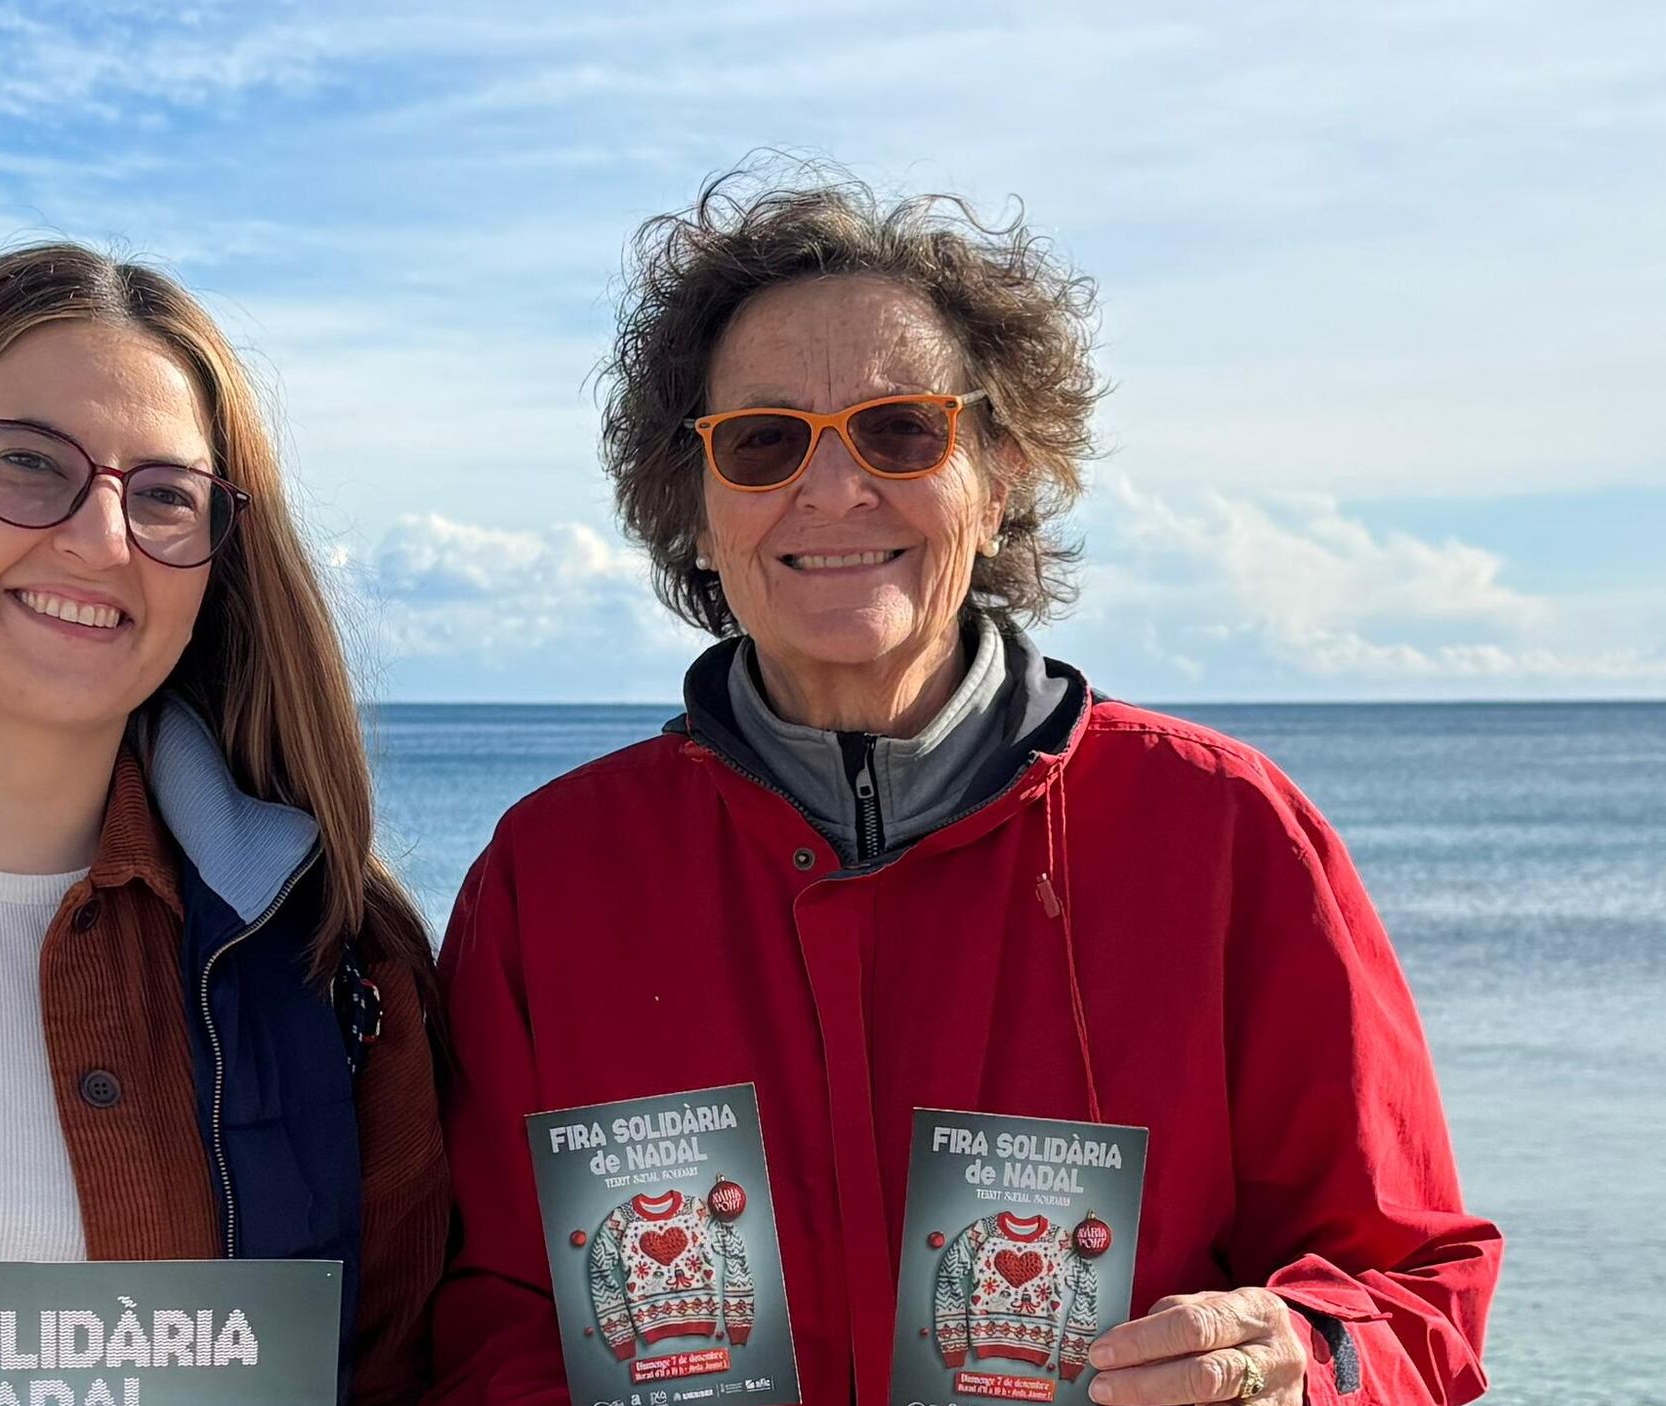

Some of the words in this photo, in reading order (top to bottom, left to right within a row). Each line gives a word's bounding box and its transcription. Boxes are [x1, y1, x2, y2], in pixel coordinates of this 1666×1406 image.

[549, 1122, 607, 1153] FIRA
[612, 1103, 737, 1144] SOLIDÀRIA
[933, 1126, 989, 1156] FIRA
[996, 1132, 1122, 1170] SOLIDÀRIA
[589, 1150, 621, 1175] de
[626, 1136, 708, 1171] NADAL
[965, 1159, 996, 1185] de
[1003, 1161, 1084, 1194] NADAL
